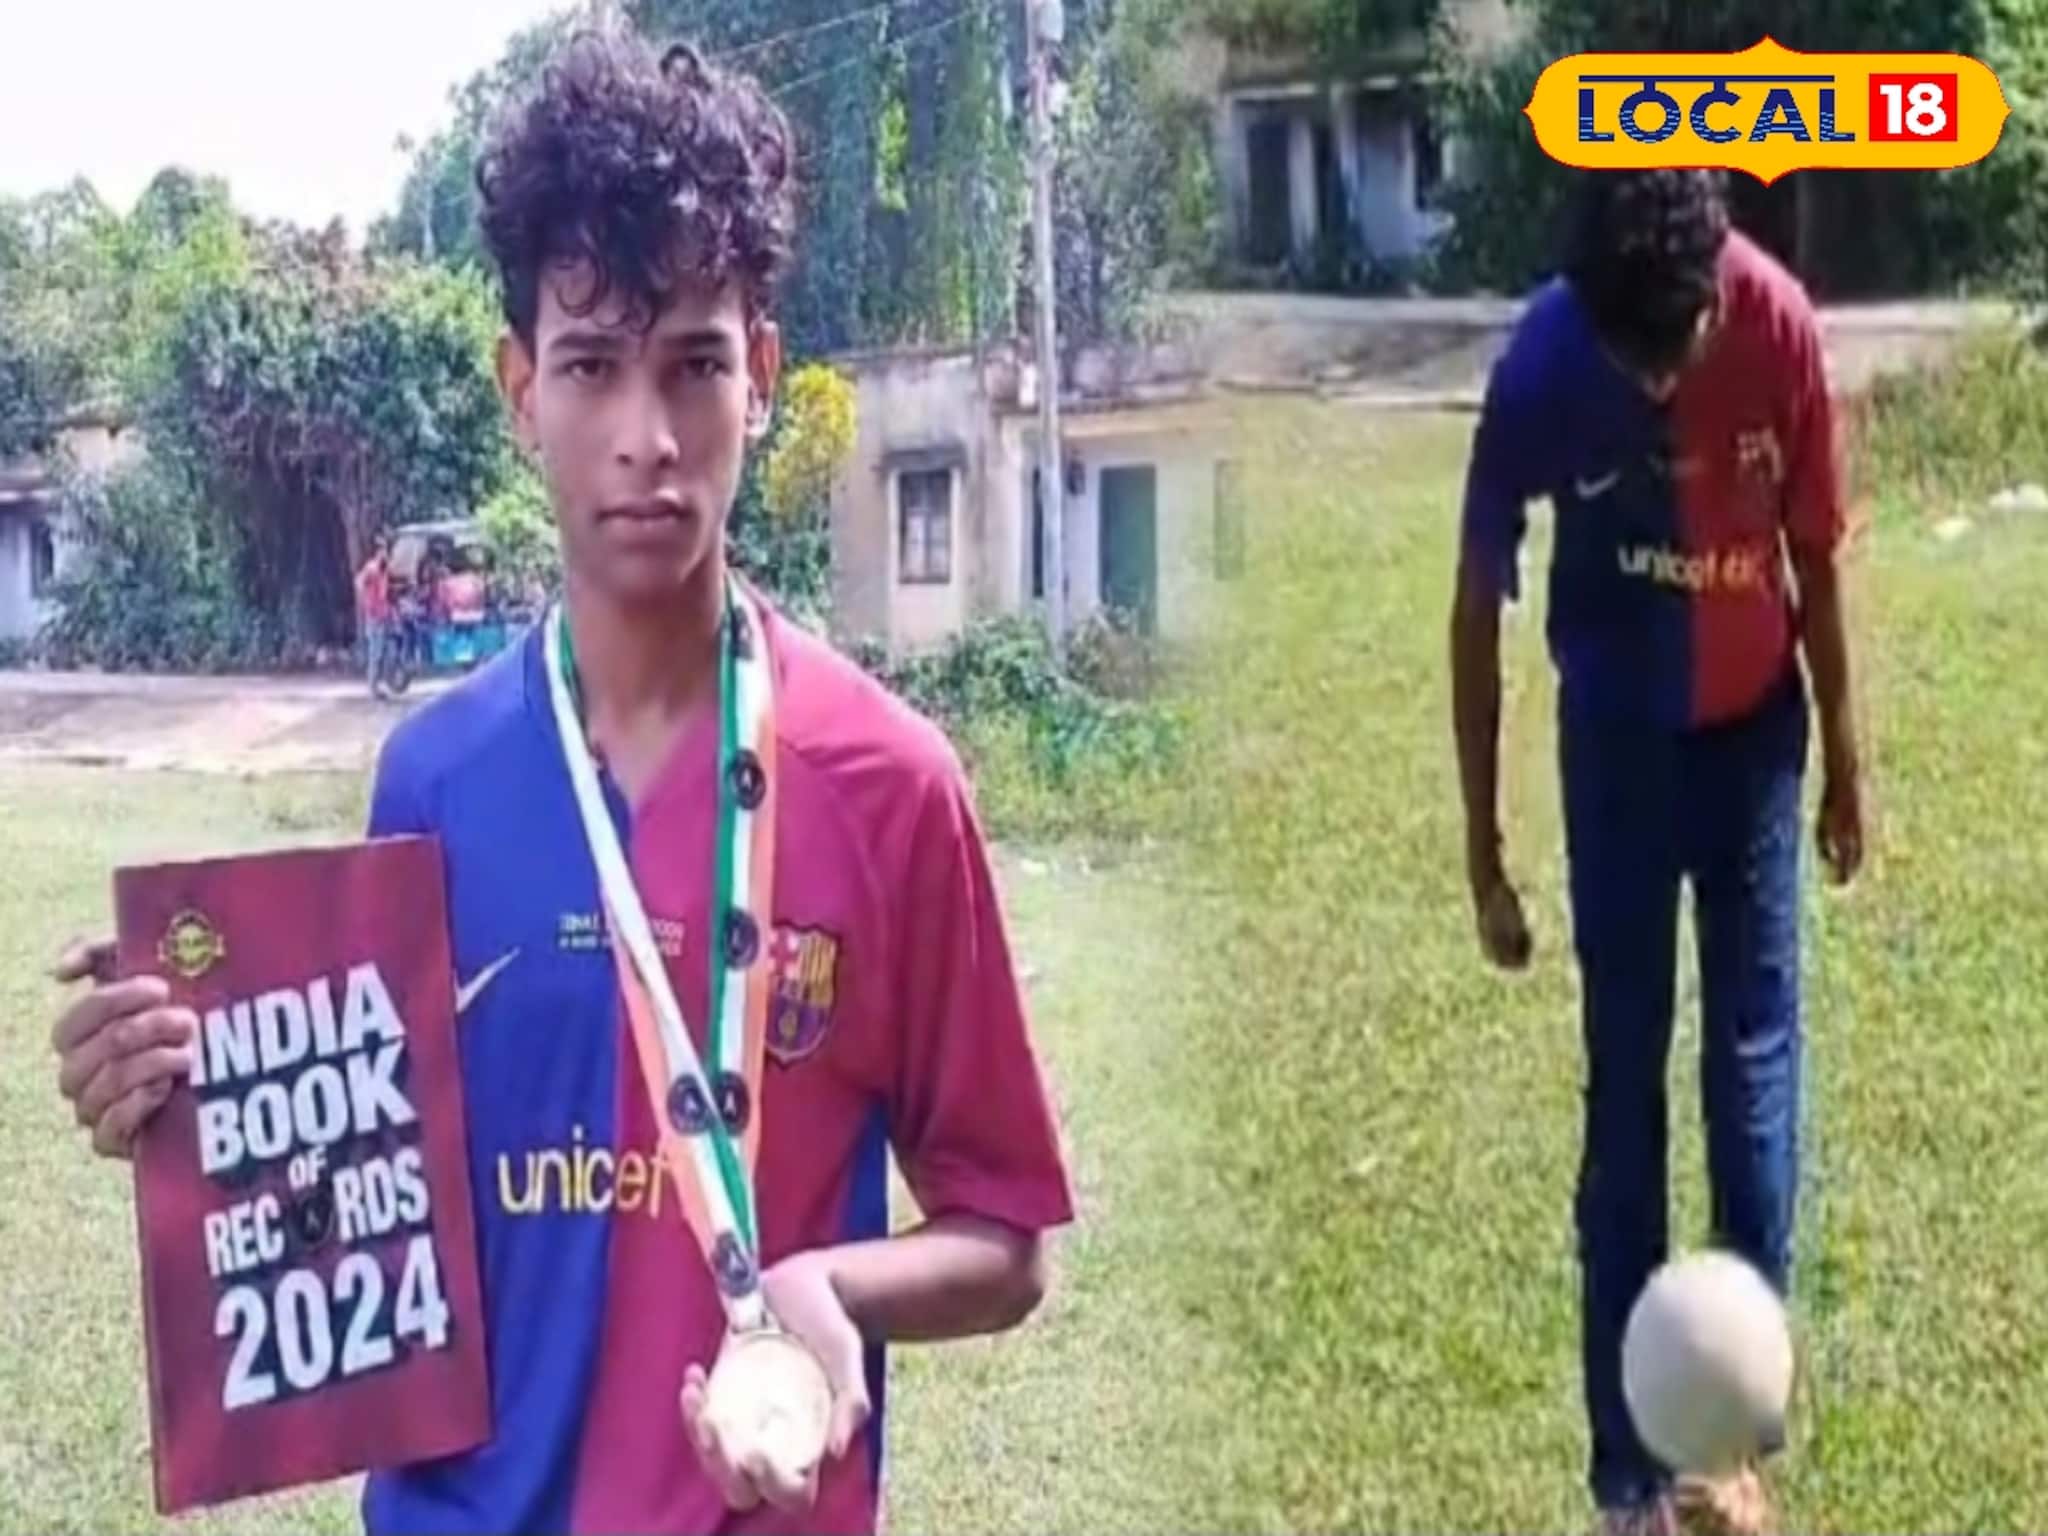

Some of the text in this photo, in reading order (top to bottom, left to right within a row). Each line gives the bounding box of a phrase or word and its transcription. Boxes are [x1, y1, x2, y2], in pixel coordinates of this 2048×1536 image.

[187, 960, 405, 1087] INDIA
[197, 1040, 416, 1175] BOOK
[288, 1144, 328, 1190] OF
[214, 1233, 448, 1411] 2024
